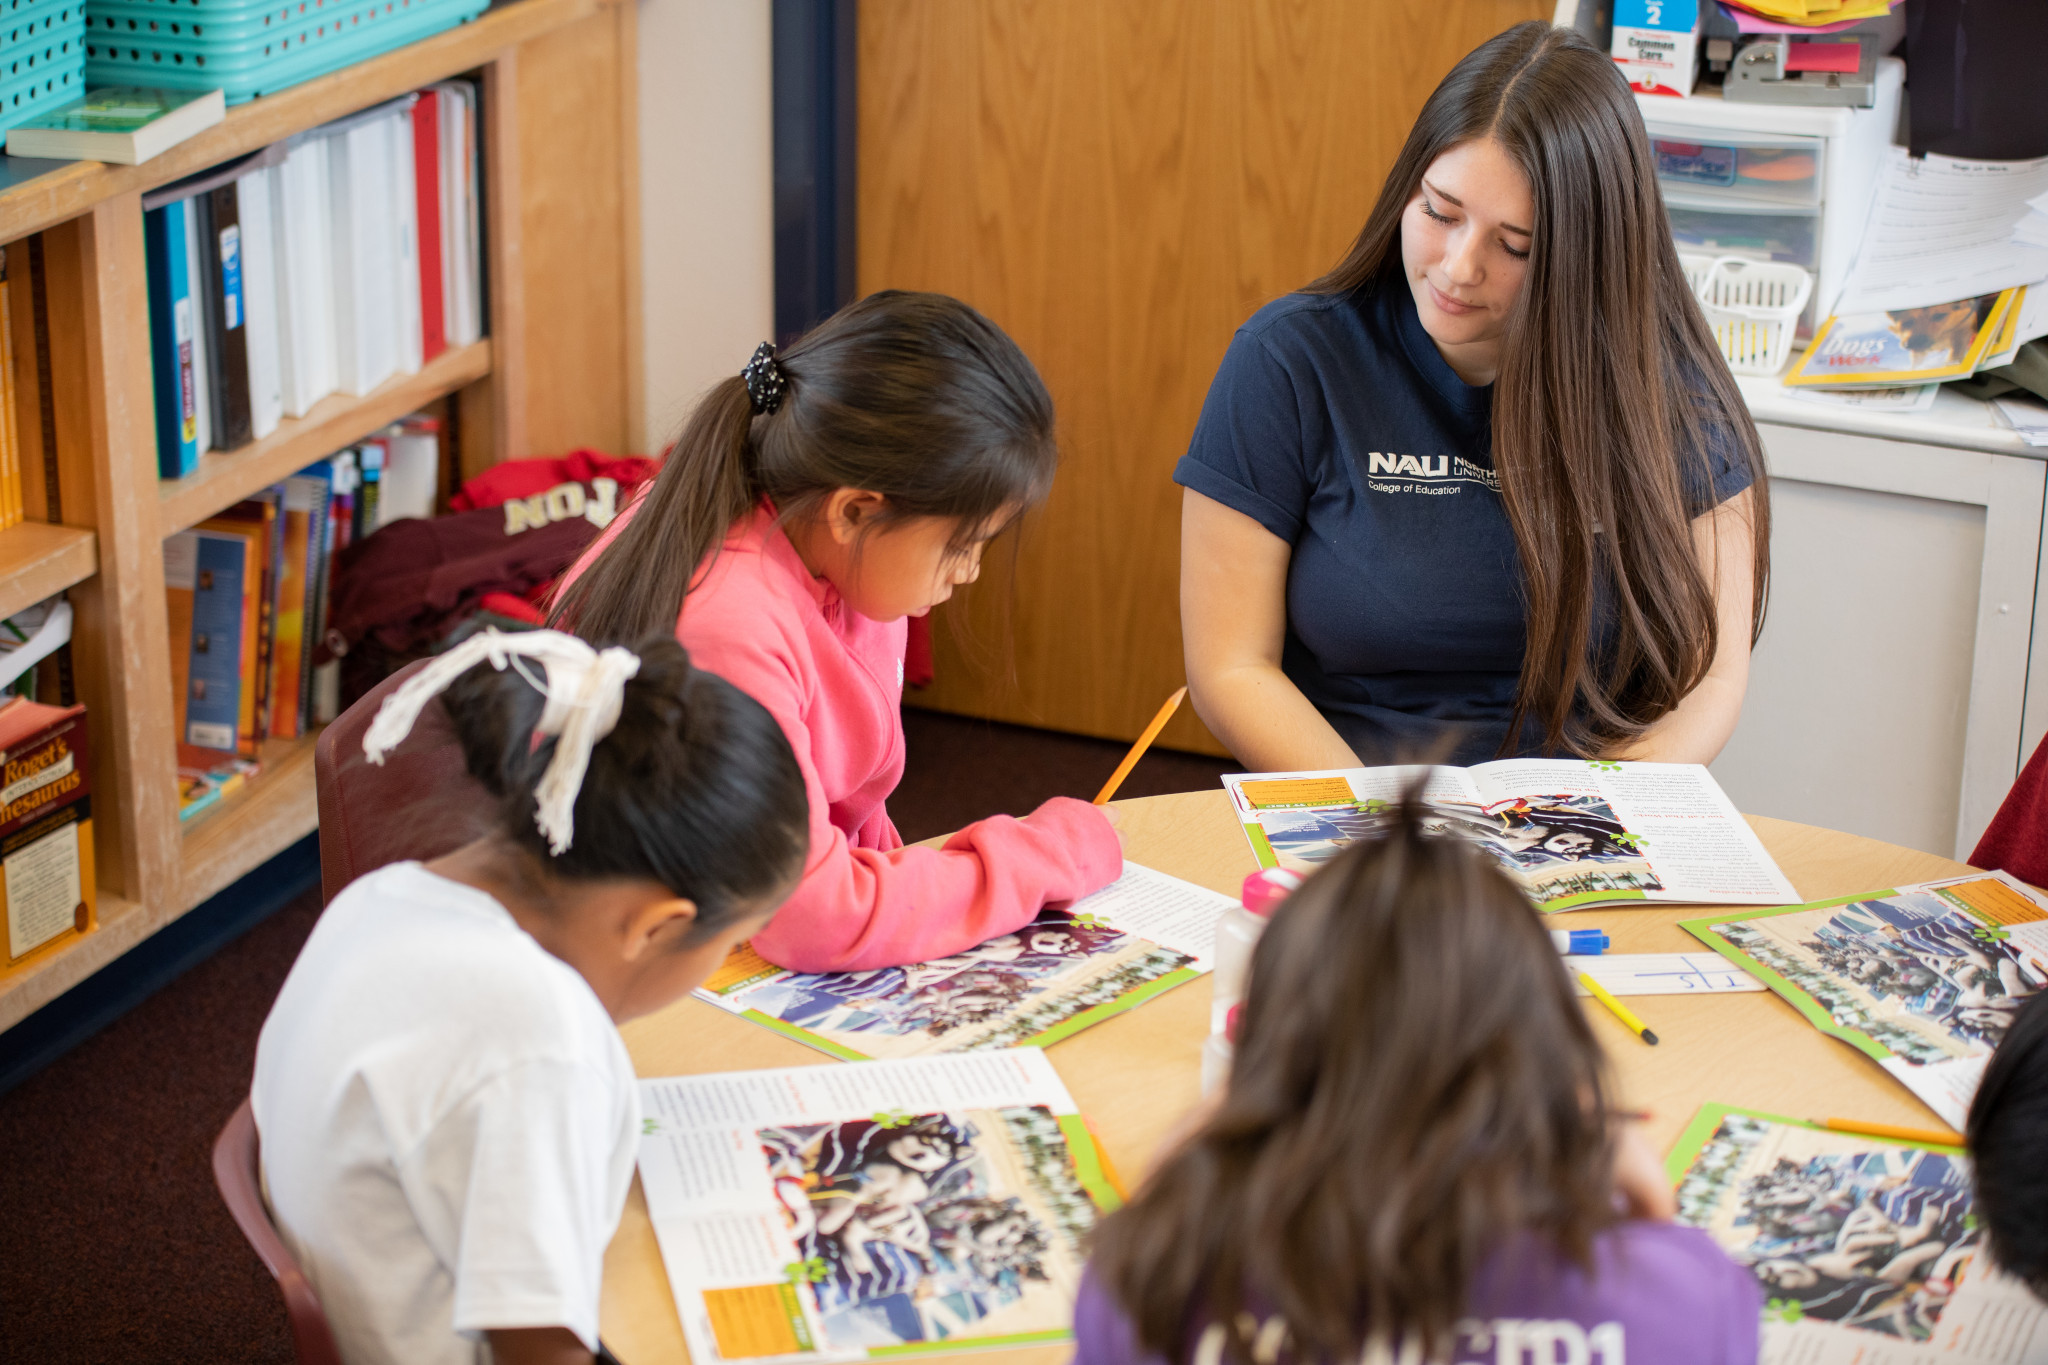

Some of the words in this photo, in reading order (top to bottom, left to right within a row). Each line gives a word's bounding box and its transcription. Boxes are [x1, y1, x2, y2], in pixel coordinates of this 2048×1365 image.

[1646, 6, 1662, 25] 2
[1628, 37, 1675, 51] Common
[1638, 49, 1663, 61] Core
[1822, 336, 1888, 358] Dogs
[1368, 452, 1449, 477] NAU
[1368, 480, 1401, 494] College
[1403, 484, 1414, 493] of
[1415, 484, 1461, 496] Education
[3, 736, 69, 788] Roget's
[0, 769, 81, 826] hesaurus
